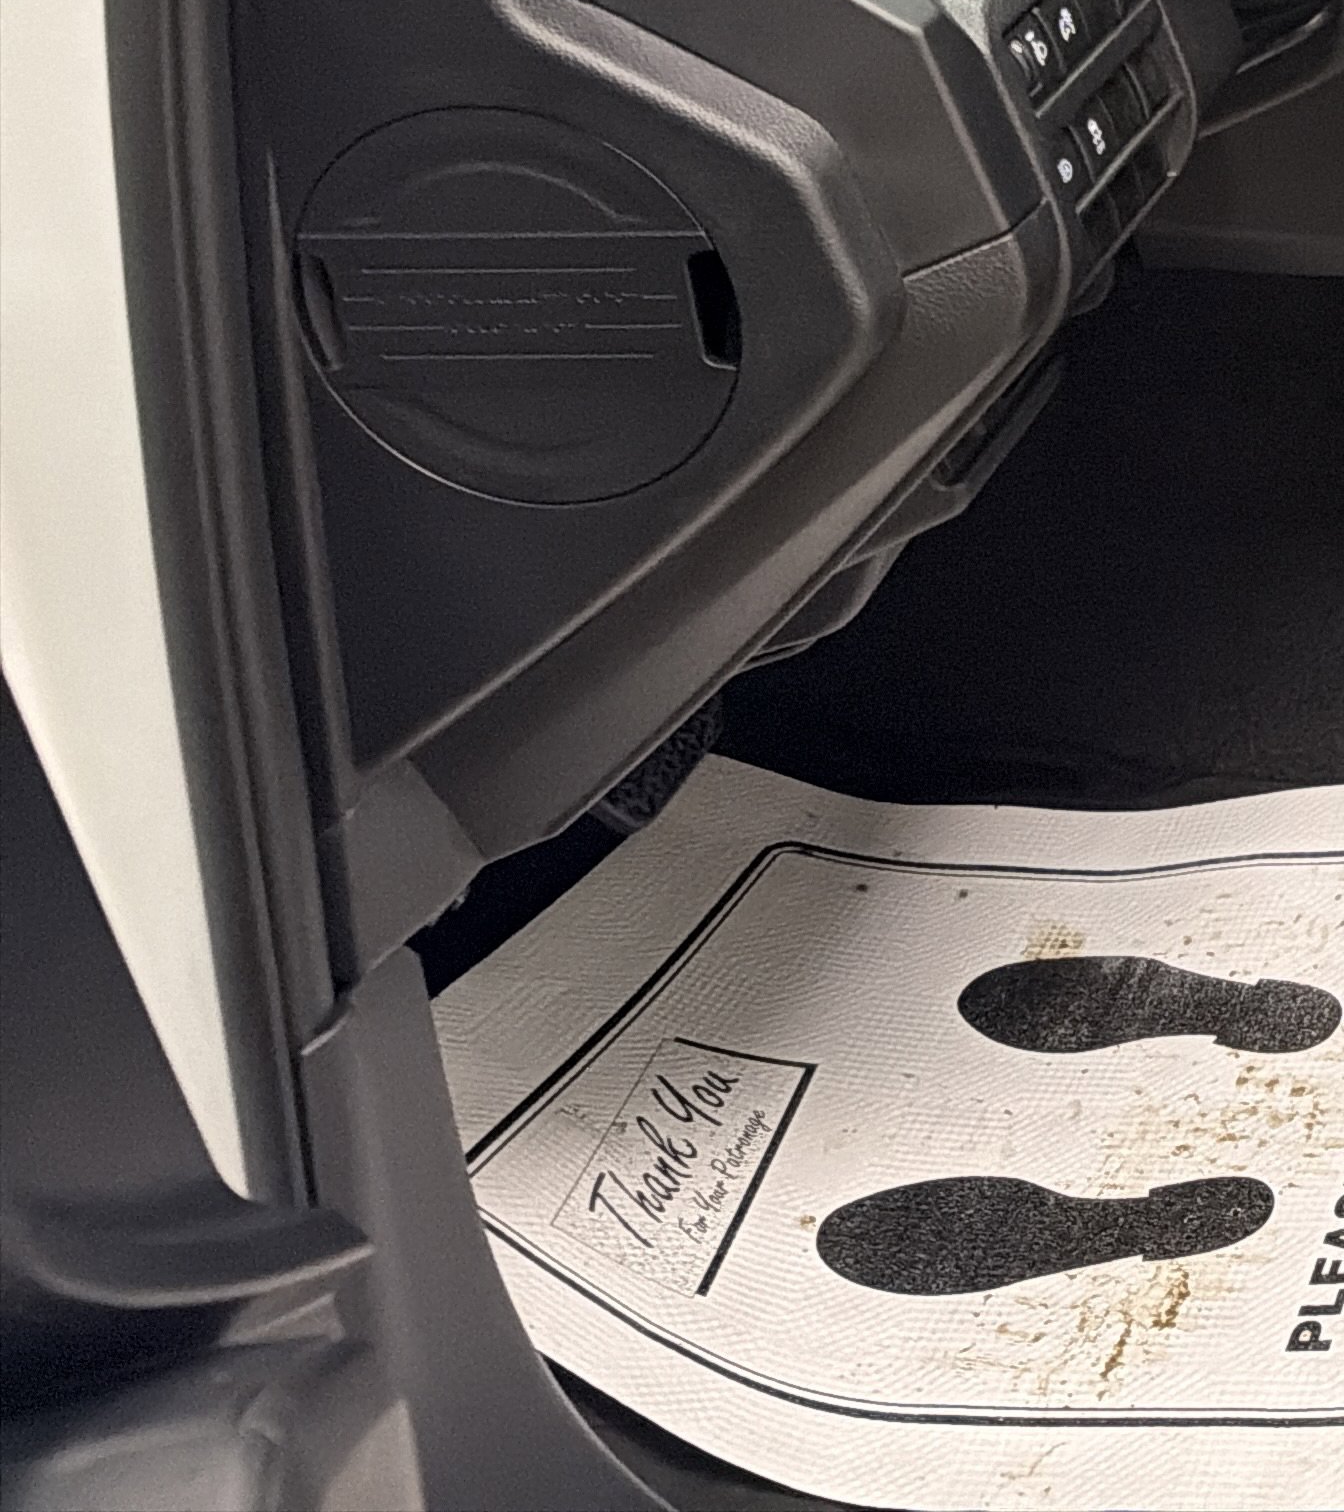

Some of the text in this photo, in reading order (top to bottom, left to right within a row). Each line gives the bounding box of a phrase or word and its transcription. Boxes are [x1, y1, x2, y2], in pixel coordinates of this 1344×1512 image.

[588, 1070, 740, 1249] Thank You
[677, 1109, 773, 1245] For Your Patronage
